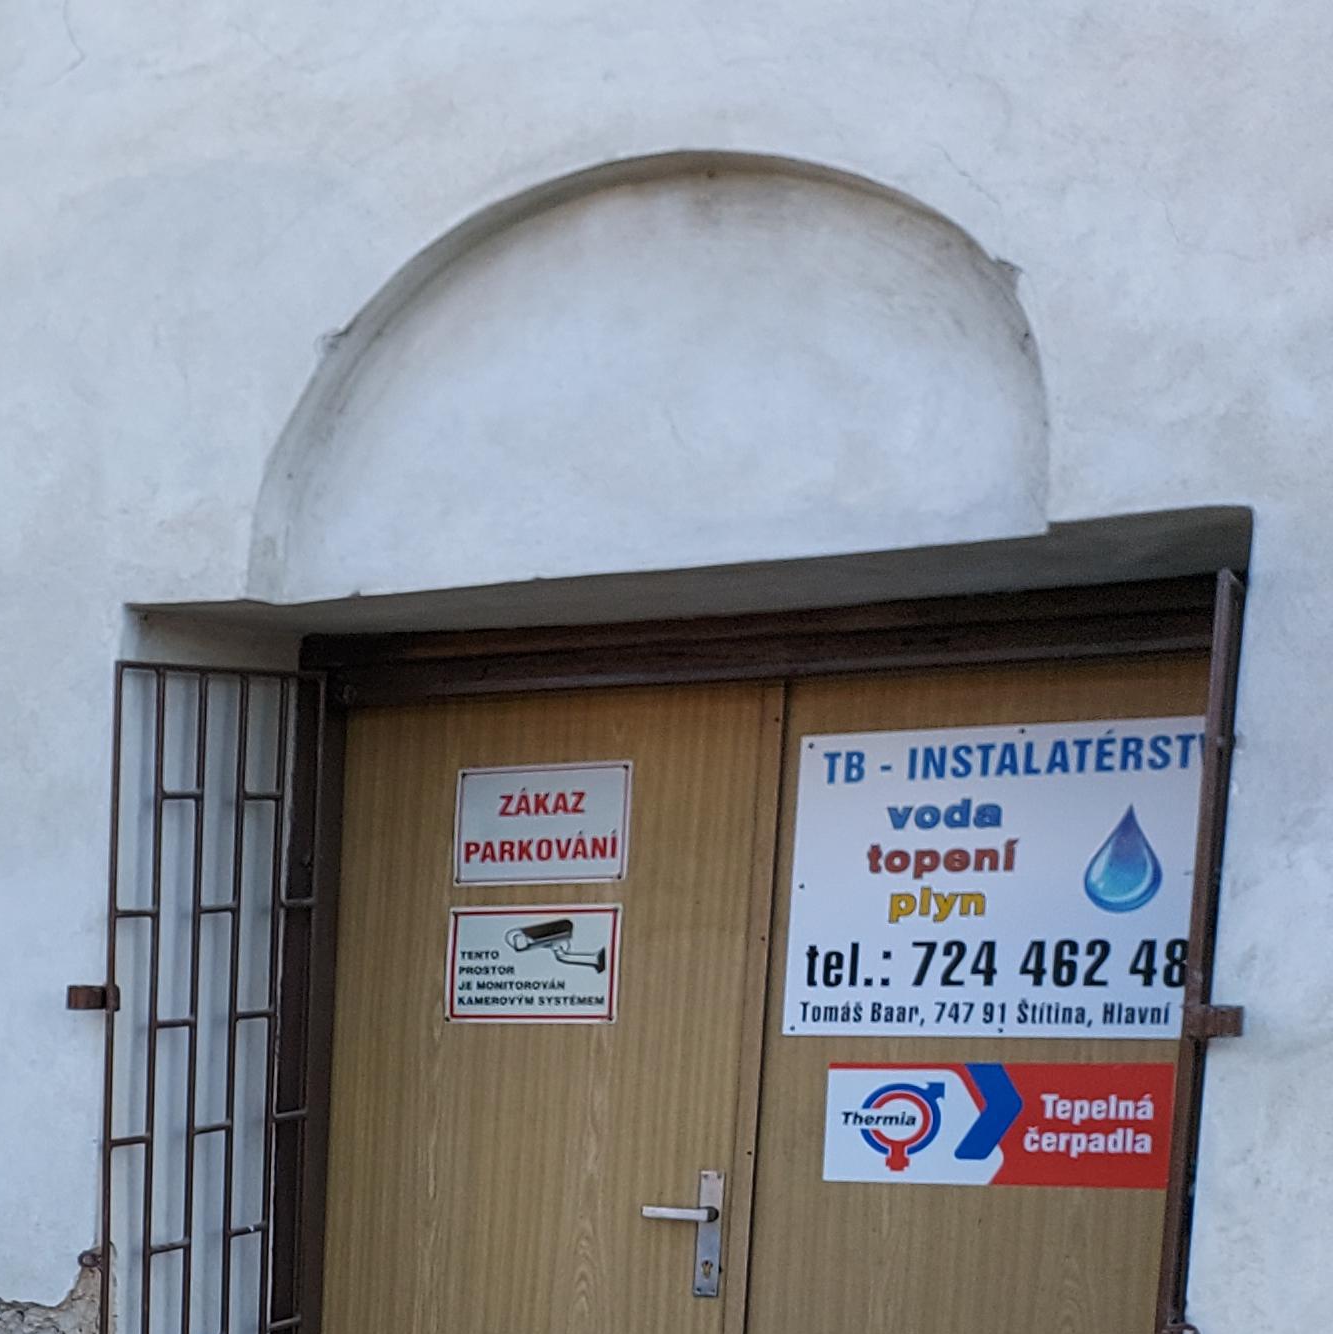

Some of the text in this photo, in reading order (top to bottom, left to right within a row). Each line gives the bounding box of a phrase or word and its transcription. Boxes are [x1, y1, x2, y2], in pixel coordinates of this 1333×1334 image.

[823, 750, 866, 784] TB
[908, 729, 1206, 780] INSTALATÉRST
[499, 788, 587, 817] ZÁKAZ
[887, 798, 1003, 830] voda
[464, 829, 618, 863] PARKOVÁNÍ
[867, 838, 1020, 879] topení
[889, 887, 986, 924] plyn
[458, 965, 515, 976] PROSTOR
[459, 950, 500, 961] TENTO
[805, 941, 891, 987] tel.:
[911, 940, 998, 987] 724
[1019, 939, 1112, 987] 462
[457, 995, 605, 1006] KAMEROVÝM SYSTÉMEM
[458, 979, 566, 991] JE MONITOROVÁN
[800, 998, 1172, 1028] Tomáš Baar, 747 91 Štítina, Hlavní
[840, 1110, 917, 1129] Thermia
[1040, 1093, 1155, 1126] Tepelná
[1023, 1126, 1153, 1159] čerpadla
